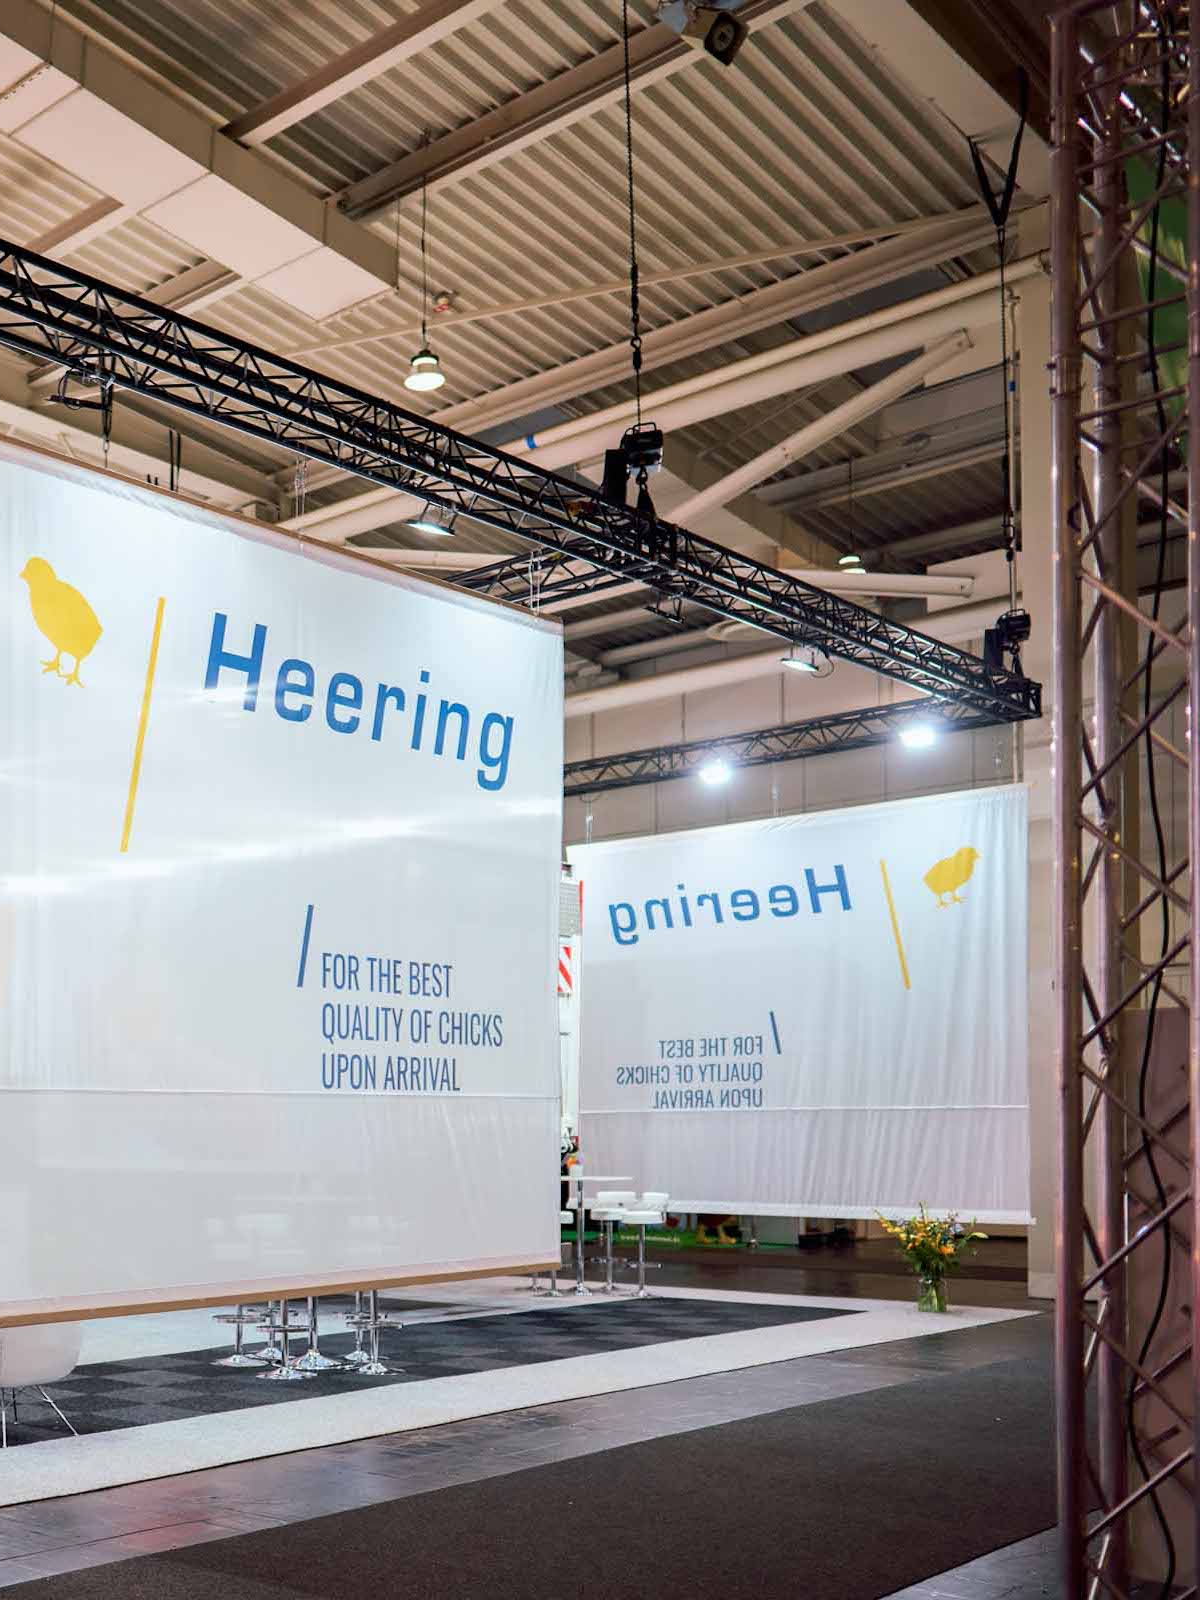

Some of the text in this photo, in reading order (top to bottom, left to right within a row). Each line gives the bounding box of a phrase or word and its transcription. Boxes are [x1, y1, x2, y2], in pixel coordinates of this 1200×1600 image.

[202, 612, 514, 791] Heering
[322, 952, 452, 998] FOR THE BEST
[322, 1002, 503, 1047] QUALITY OF CHICKS
[322, 1053, 460, 1091] UPON ARRIVAL
